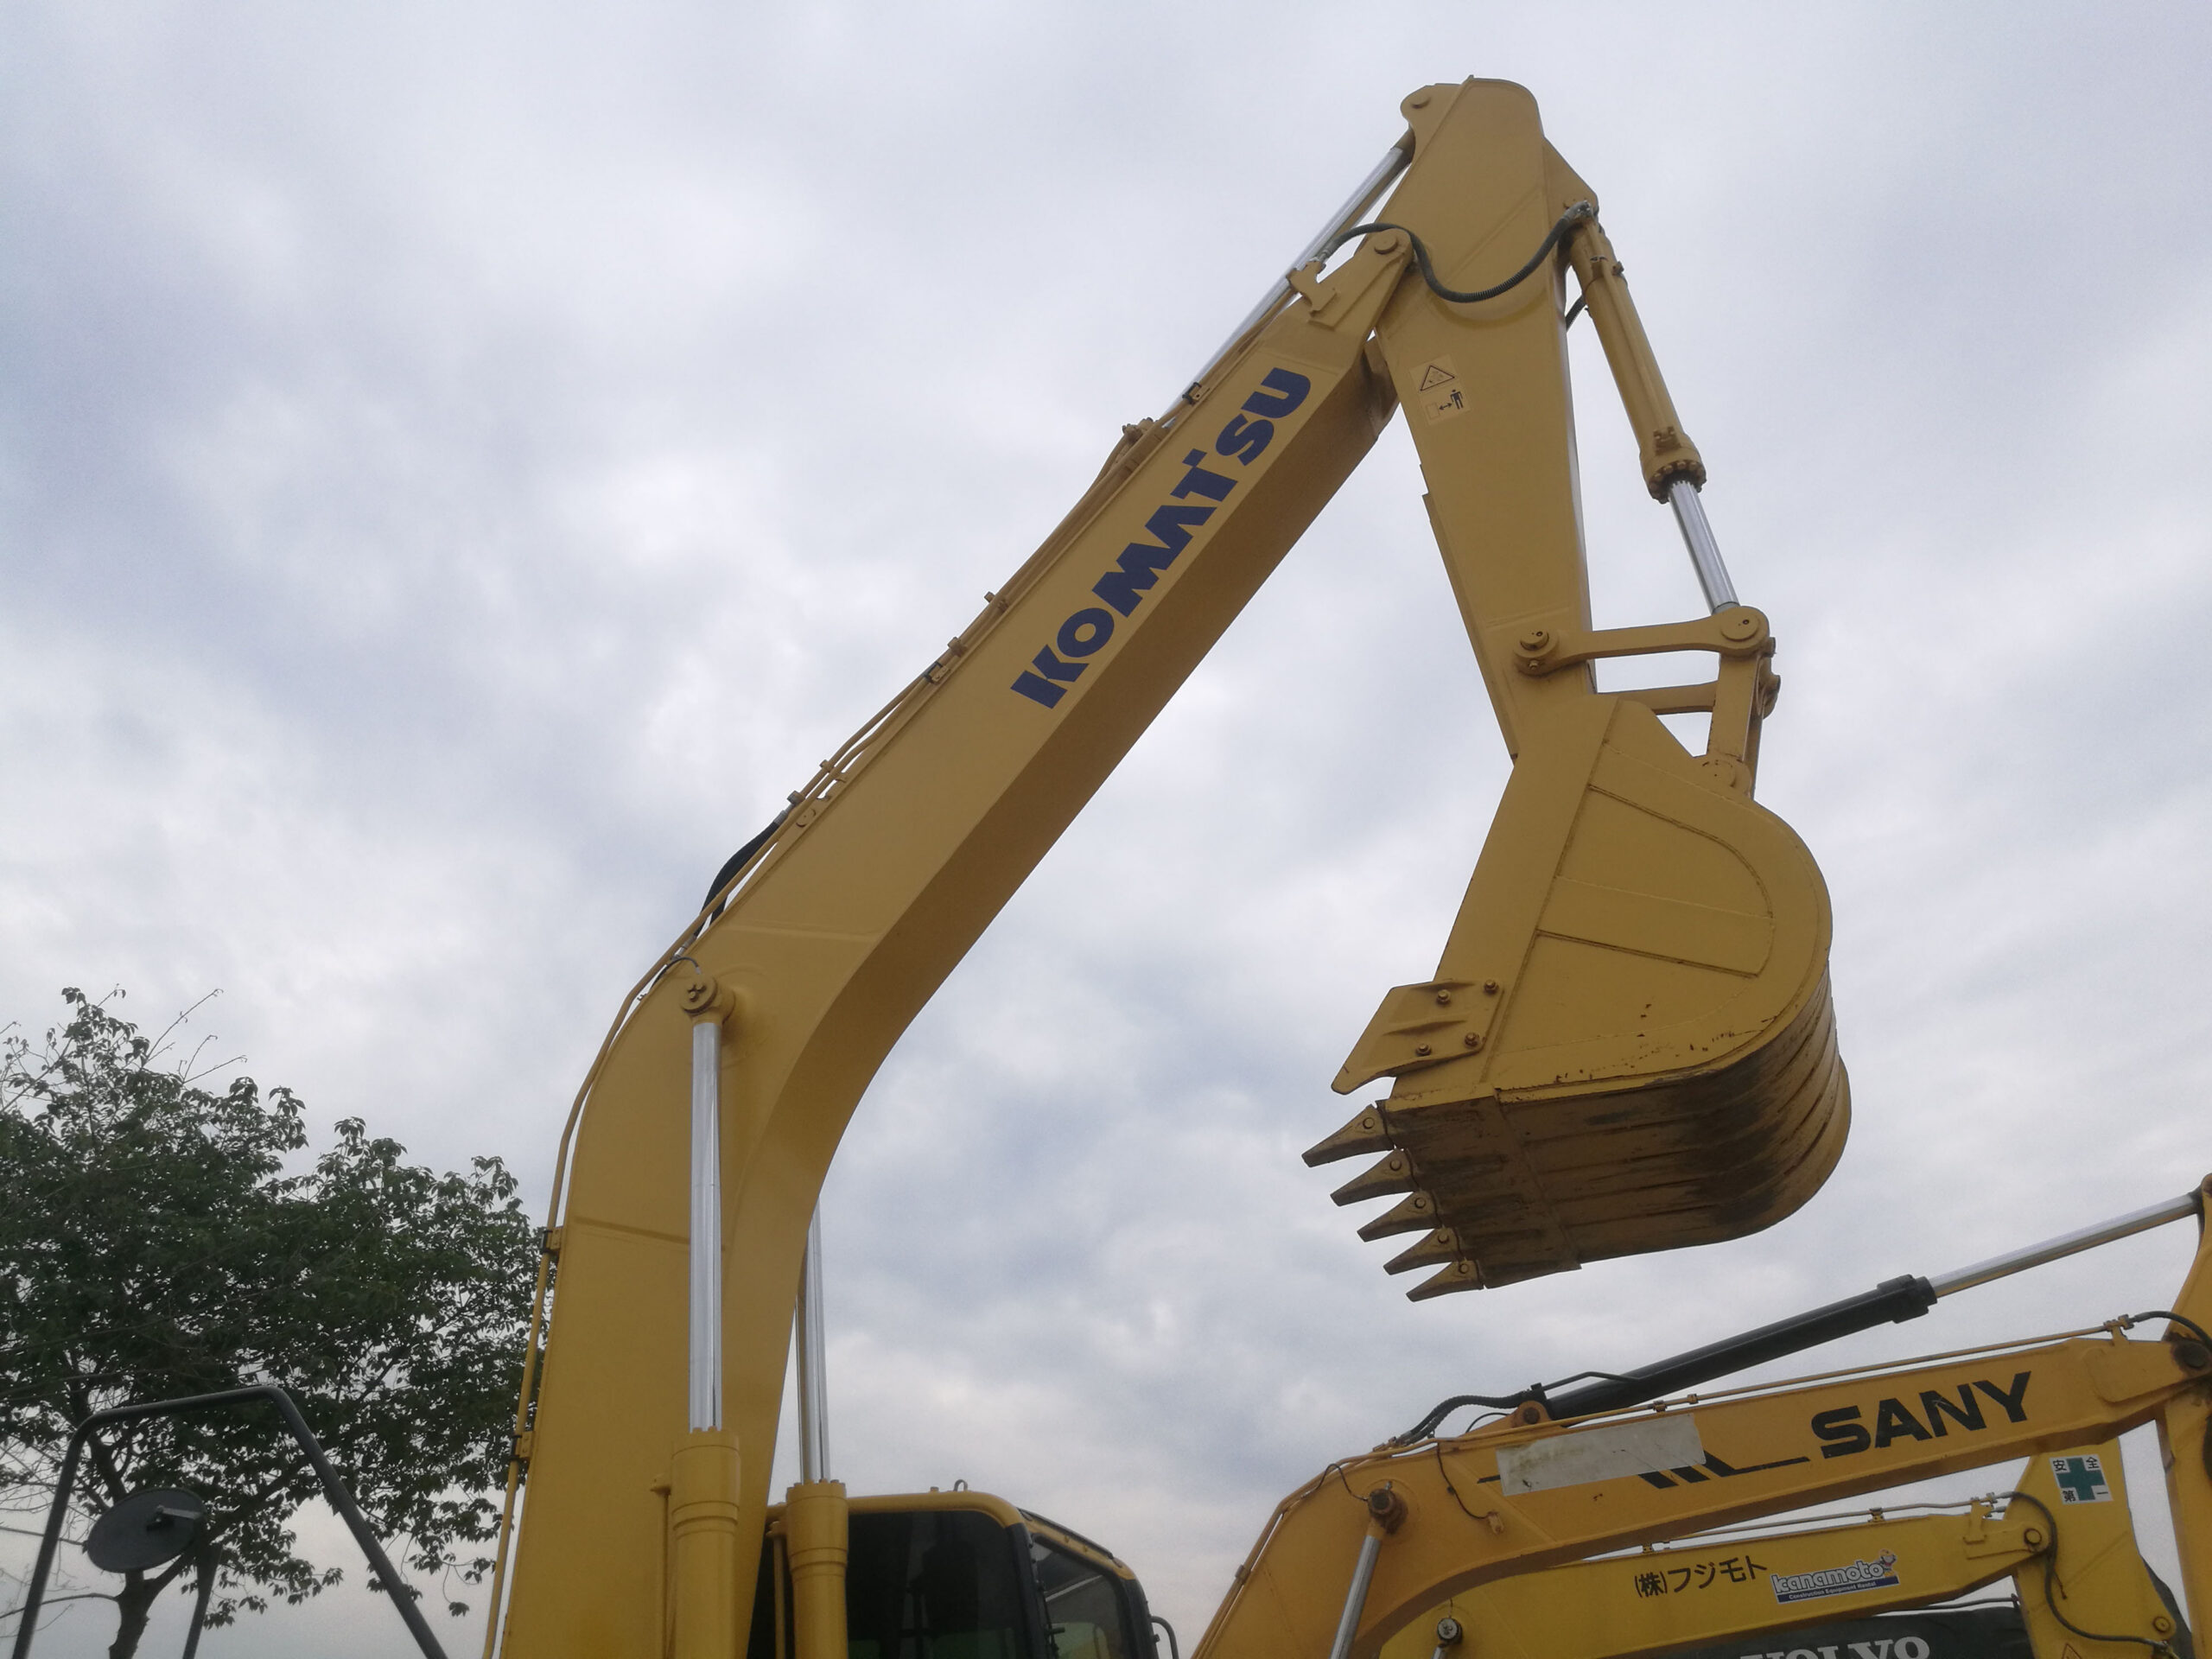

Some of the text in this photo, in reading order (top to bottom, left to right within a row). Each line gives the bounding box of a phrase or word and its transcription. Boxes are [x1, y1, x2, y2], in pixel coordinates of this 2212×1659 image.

[1010, 367, 1311, 709] KOMATSU
[1811, 1371, 2031, 1459] SANY
[1771, 1560, 1885, 1593] kanamoto
[1740, 1636, 1930, 1659] LVO
